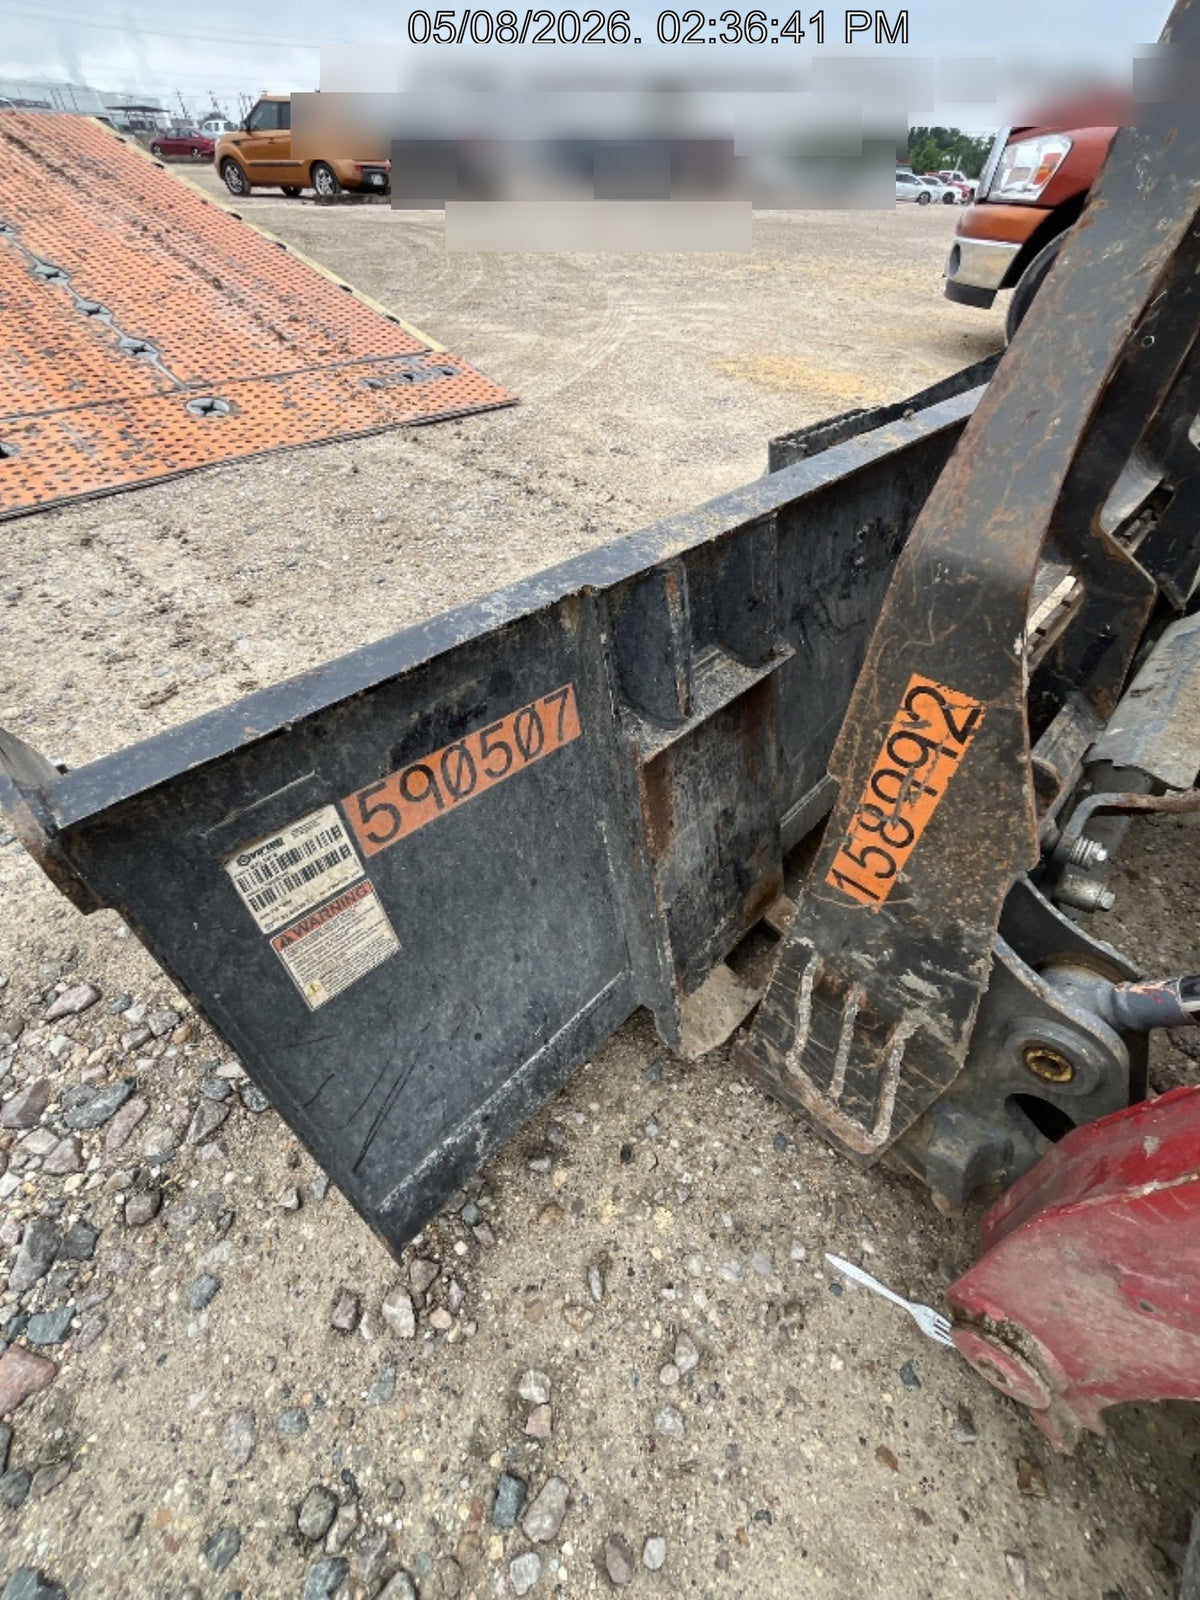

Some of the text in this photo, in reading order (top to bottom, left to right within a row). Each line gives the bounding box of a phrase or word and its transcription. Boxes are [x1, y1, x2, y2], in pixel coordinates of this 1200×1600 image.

[357, 687, 571, 844] 590507
[831, 685, 984, 900] 158992
[292, 882, 370, 938] WARNING
